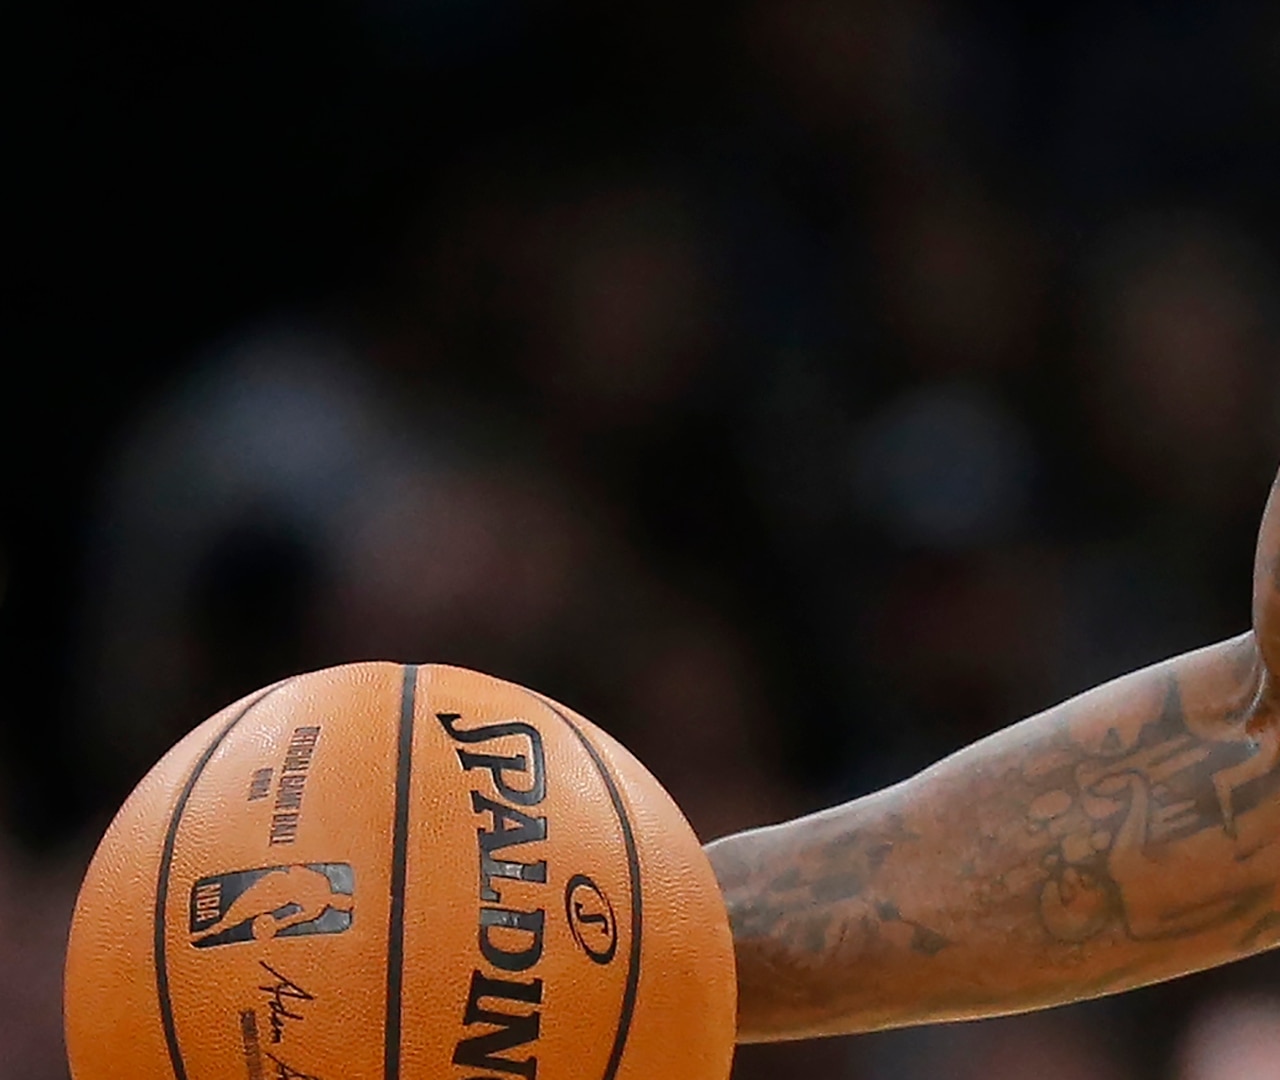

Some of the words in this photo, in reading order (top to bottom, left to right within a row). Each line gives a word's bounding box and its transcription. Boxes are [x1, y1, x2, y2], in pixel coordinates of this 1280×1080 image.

[268, 813, 299, 847] BALL
[196, 882, 222, 923] NBA
[435, 712, 548, 1080] SPALDIN
